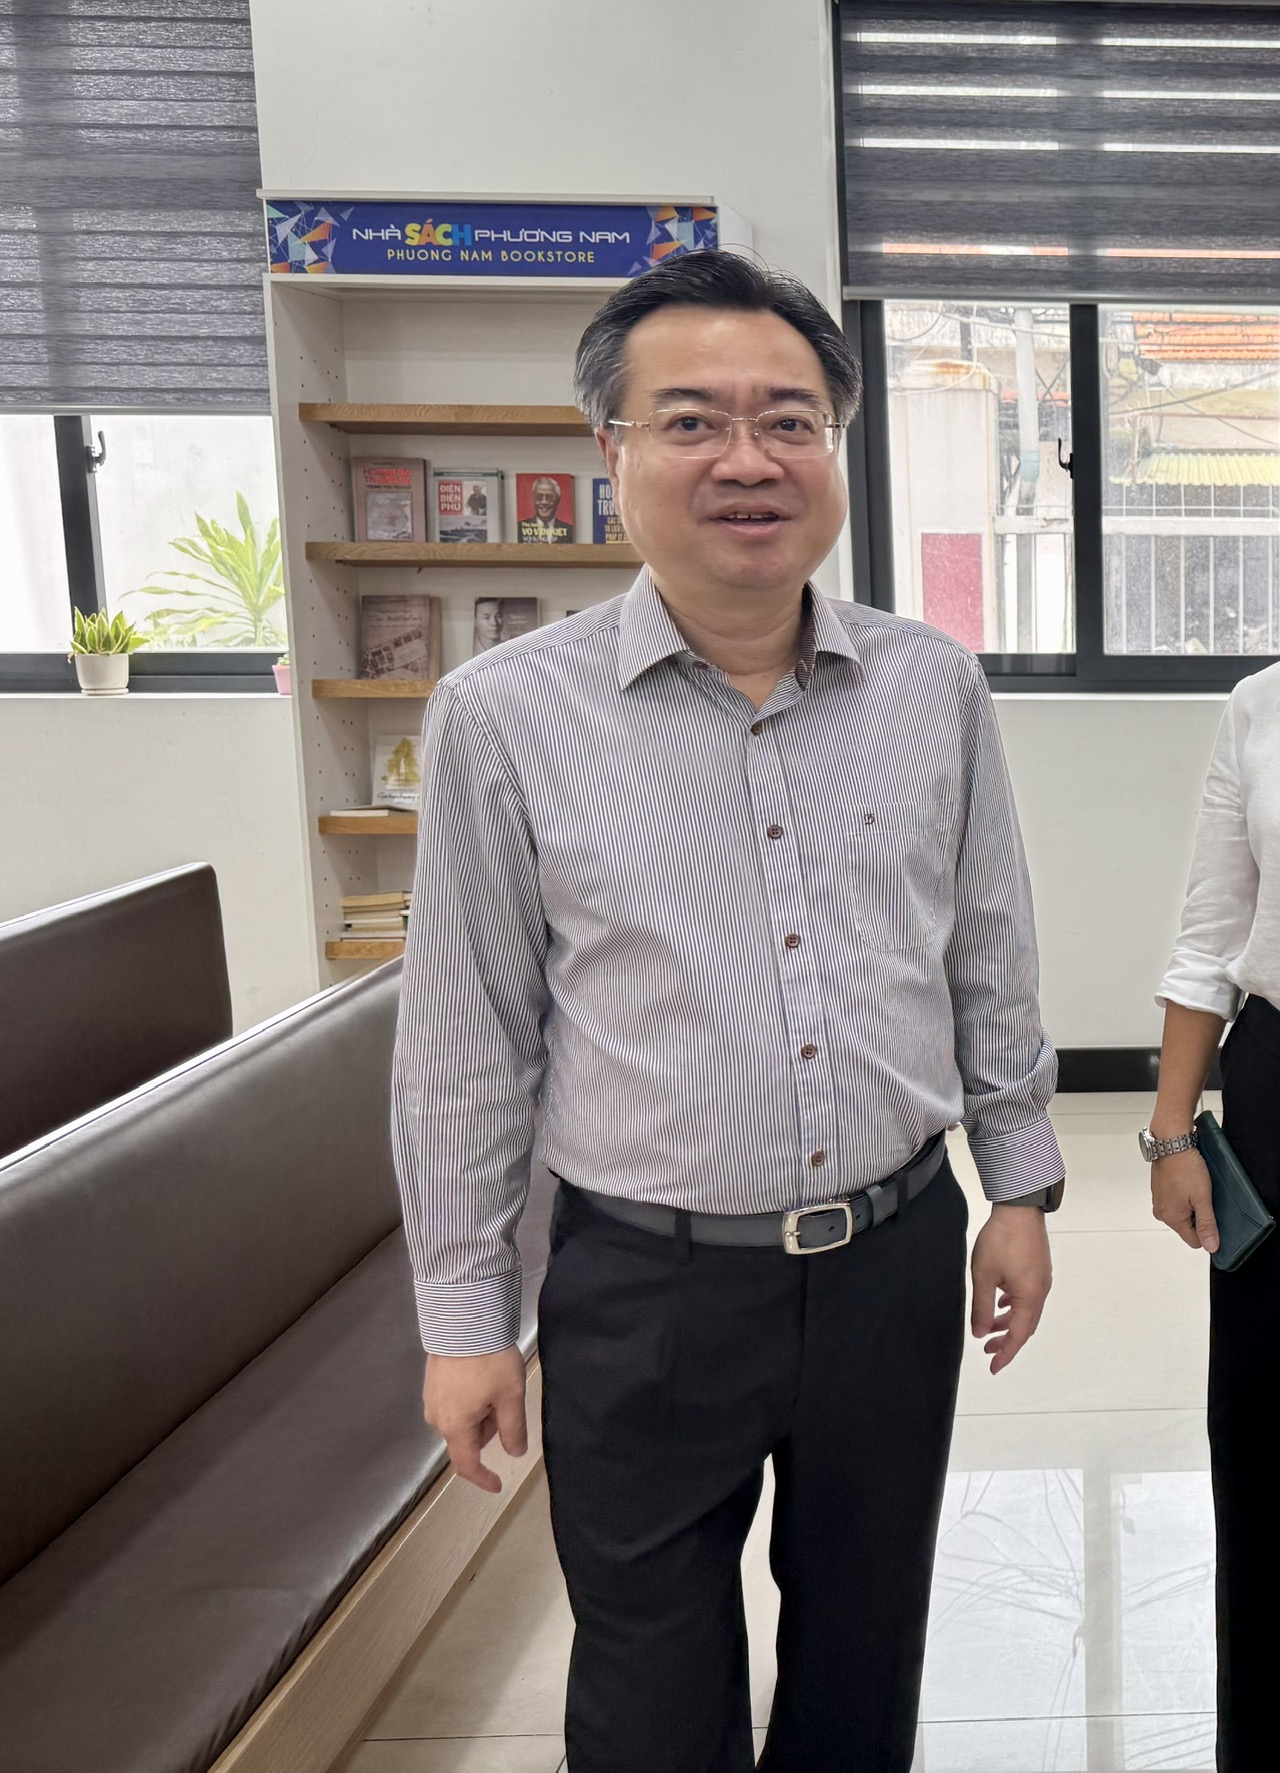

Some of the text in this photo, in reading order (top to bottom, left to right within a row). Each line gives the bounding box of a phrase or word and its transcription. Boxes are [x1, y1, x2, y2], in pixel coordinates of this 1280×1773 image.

[352, 218, 631, 247] NHÀ SÁCH PHƯƠNG NAM
[387, 249, 595, 263] PHUONG NAM BOOKSTORE
